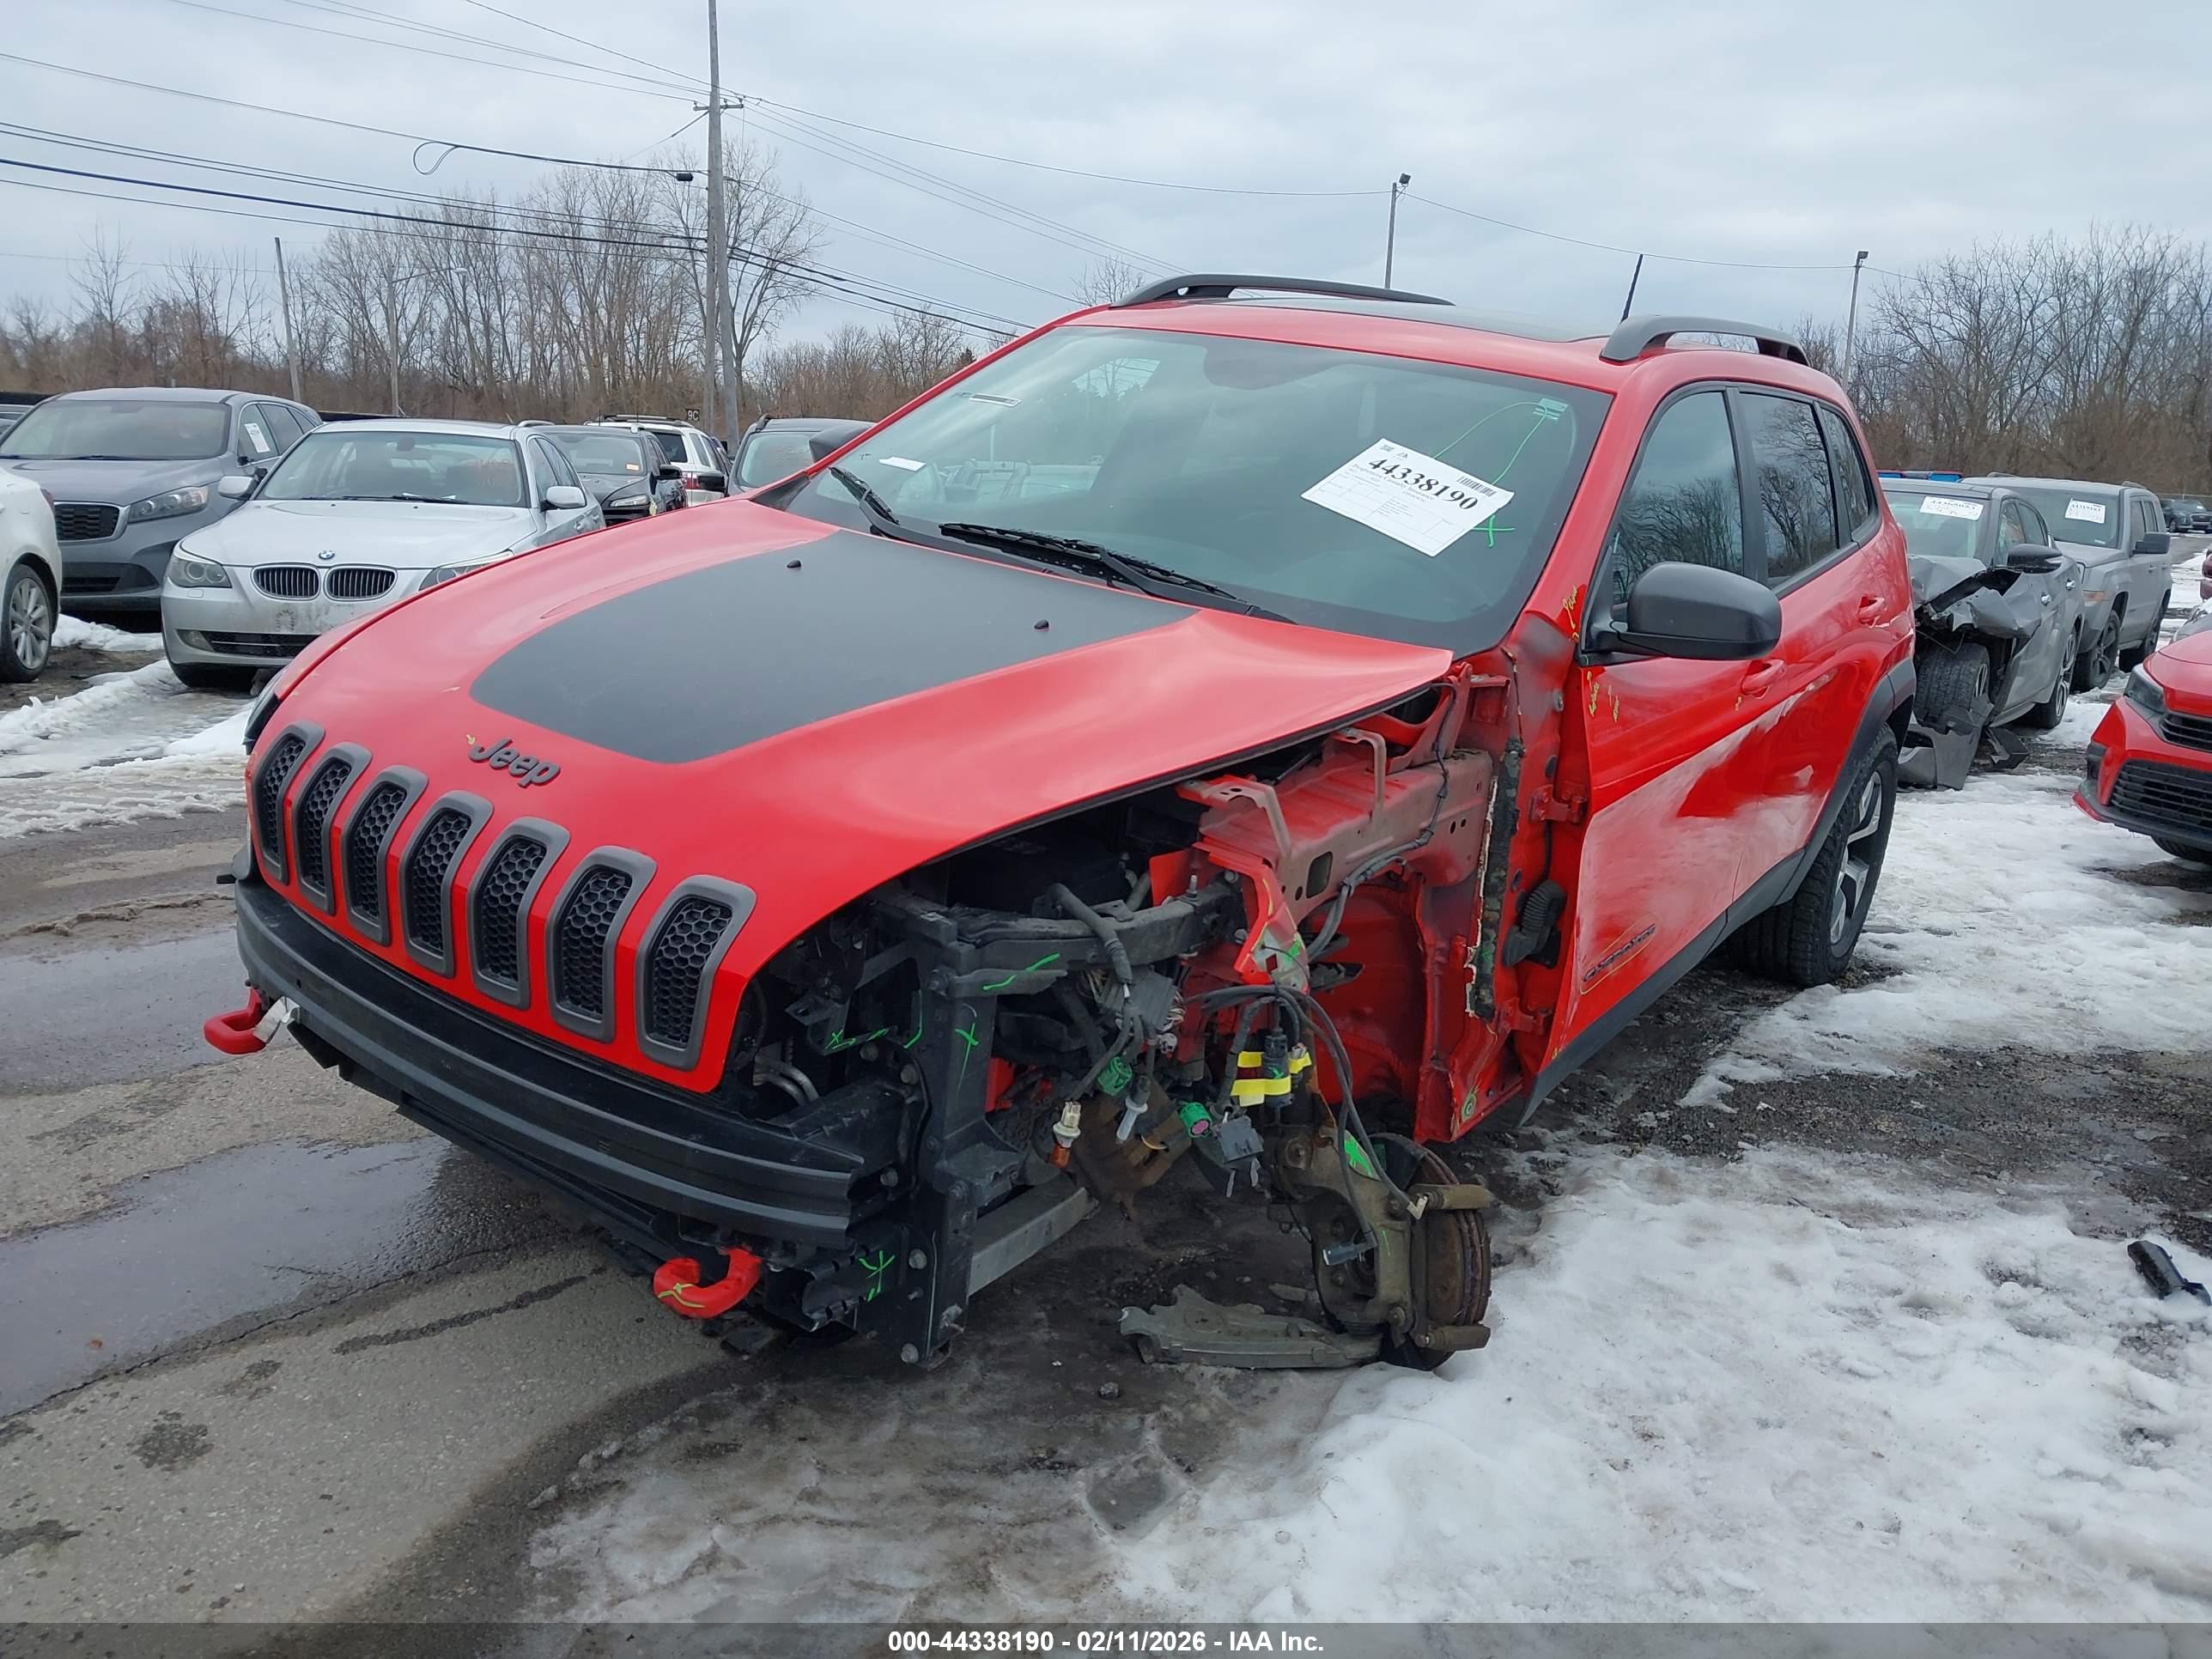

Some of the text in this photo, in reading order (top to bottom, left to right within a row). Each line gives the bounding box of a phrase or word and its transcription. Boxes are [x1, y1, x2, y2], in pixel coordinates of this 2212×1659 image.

[688, 410, 699, 421] 9C
[1369, 459, 1479, 510] 44338190
[469, 737, 561, 788] Jeep
